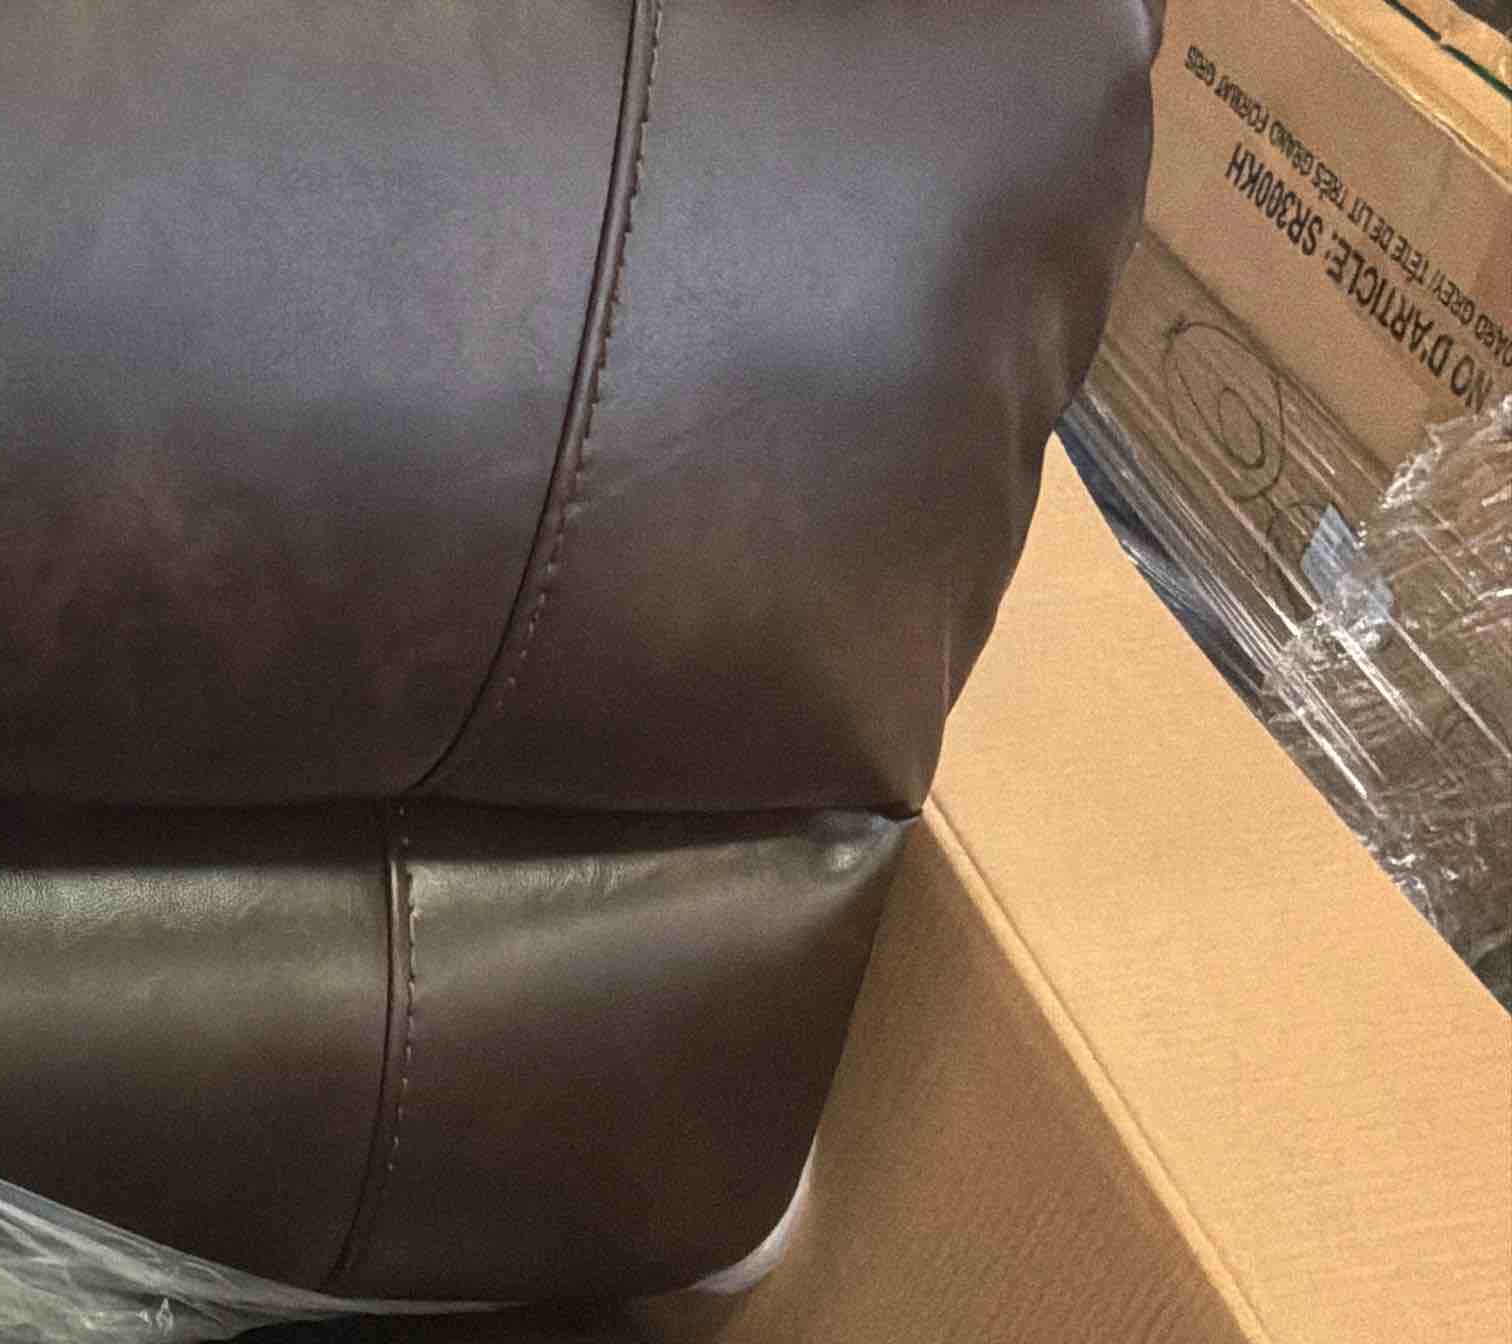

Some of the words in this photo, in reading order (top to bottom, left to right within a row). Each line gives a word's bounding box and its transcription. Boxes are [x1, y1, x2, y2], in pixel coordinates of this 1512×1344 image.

[1224, 141, 1324, 256] SR300KH
[1347, 196, 1374, 234] LIT
[1369, 218, 1395, 252] DE
